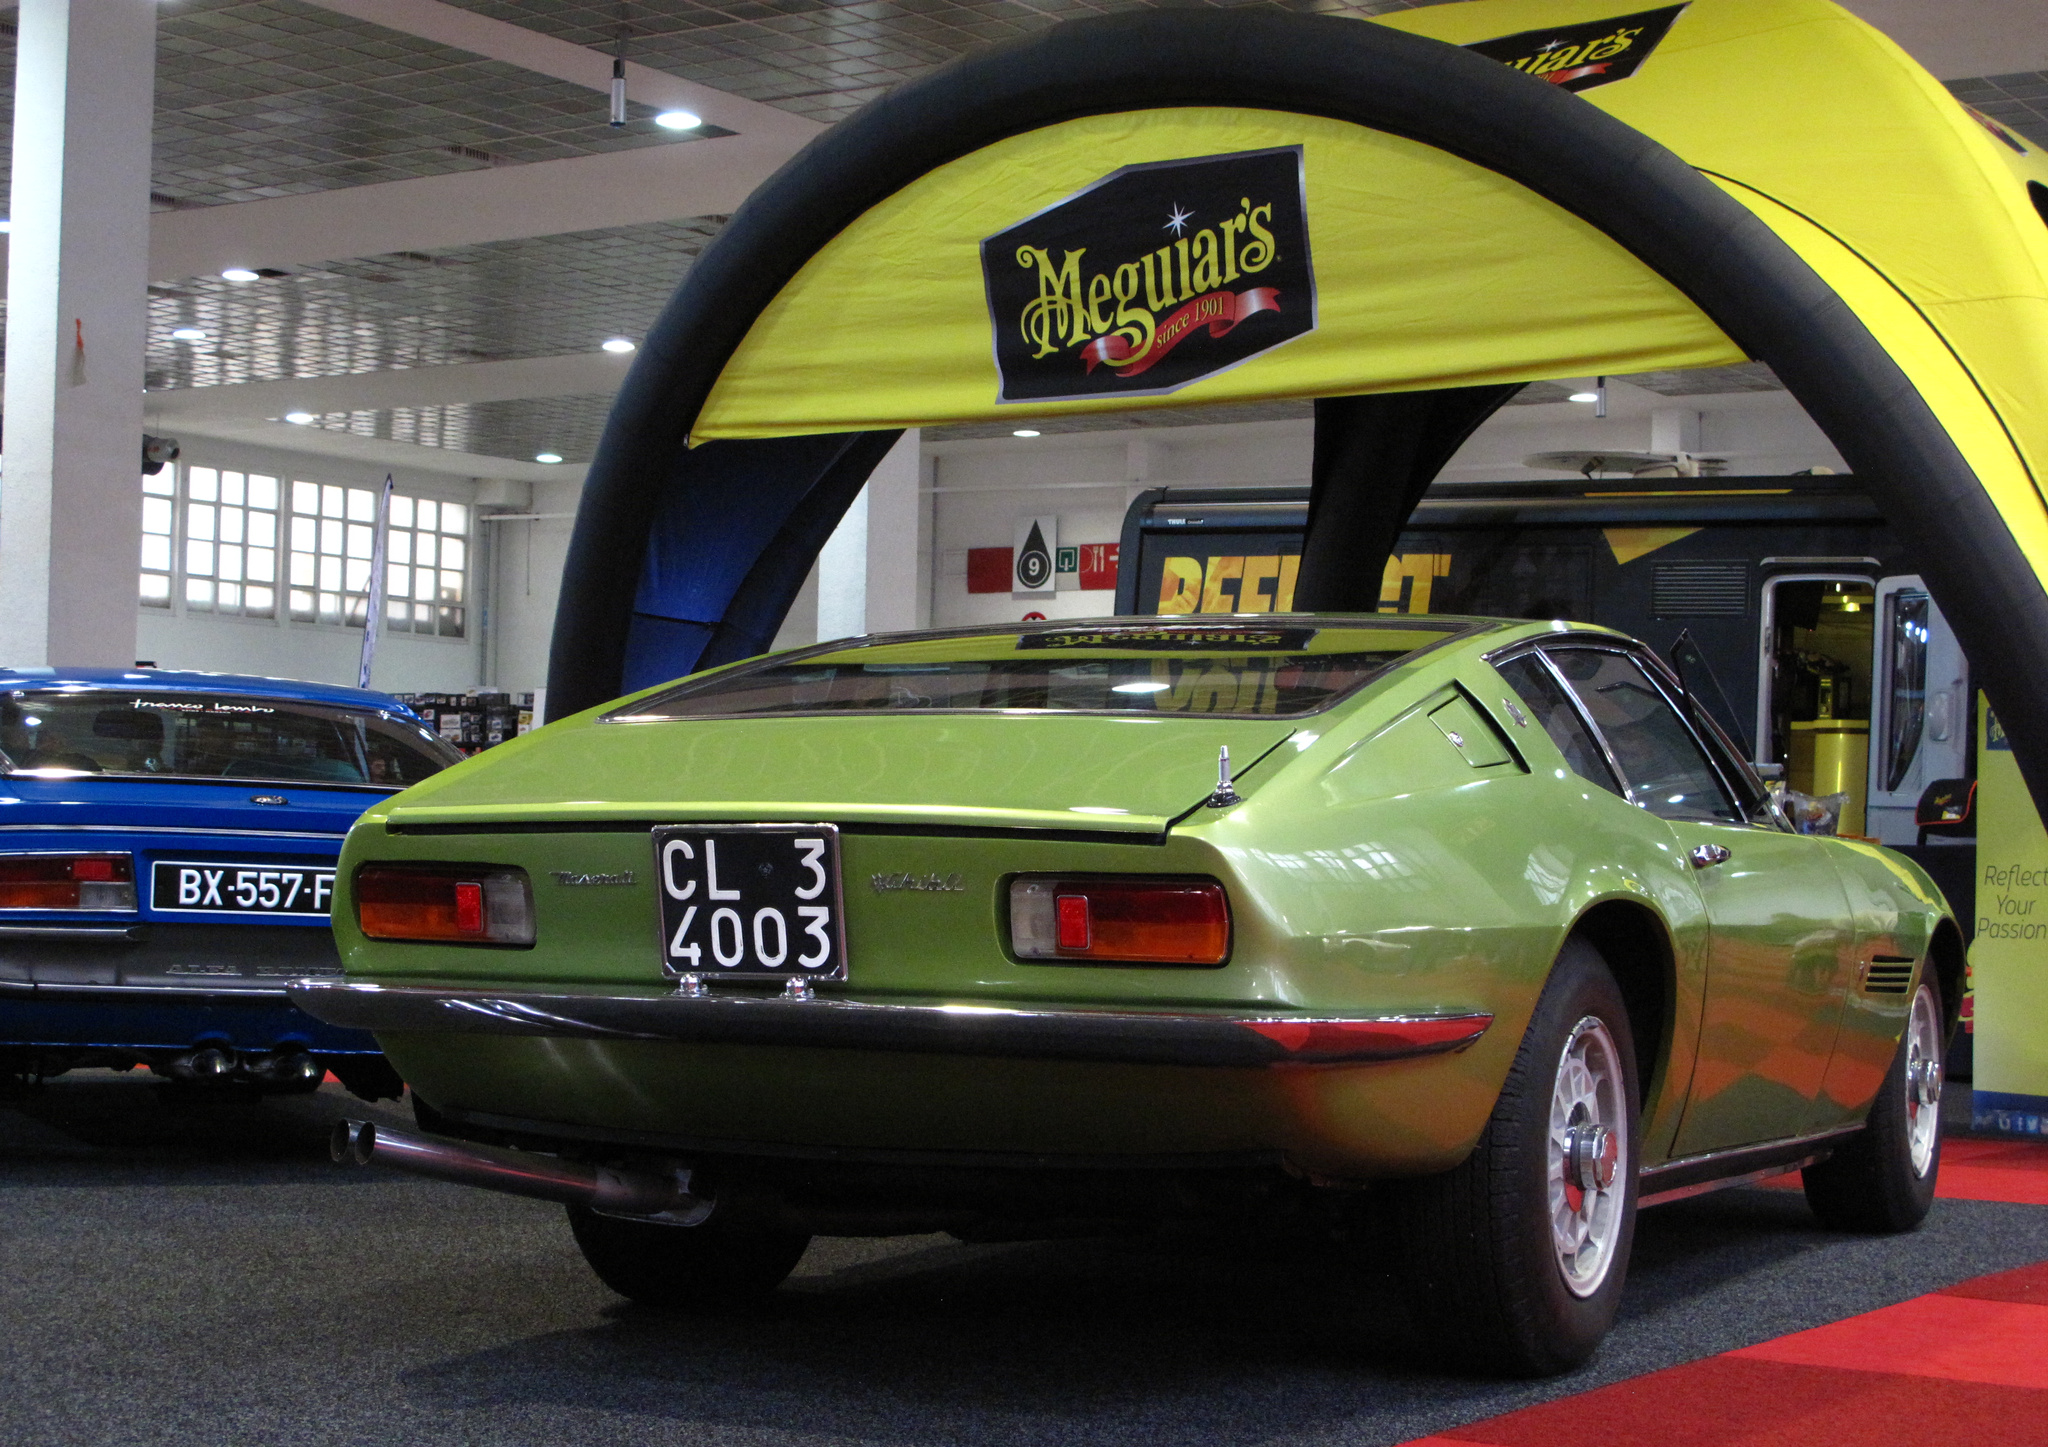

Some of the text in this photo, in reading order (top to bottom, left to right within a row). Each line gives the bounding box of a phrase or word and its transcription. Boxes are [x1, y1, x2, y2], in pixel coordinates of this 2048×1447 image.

[1016, 197, 1276, 367] Meguiar's
[1157, 296, 1224, 349] since 1901
[1028, 557, 1041, 576] 9
[662, 838, 826, 900] CL 3
[1984, 864, 2048, 892] Reflect
[1997, 894, 2036, 916] Your
[670, 905, 831, 968] 4003
[1977, 918, 2047, 941] Passion
